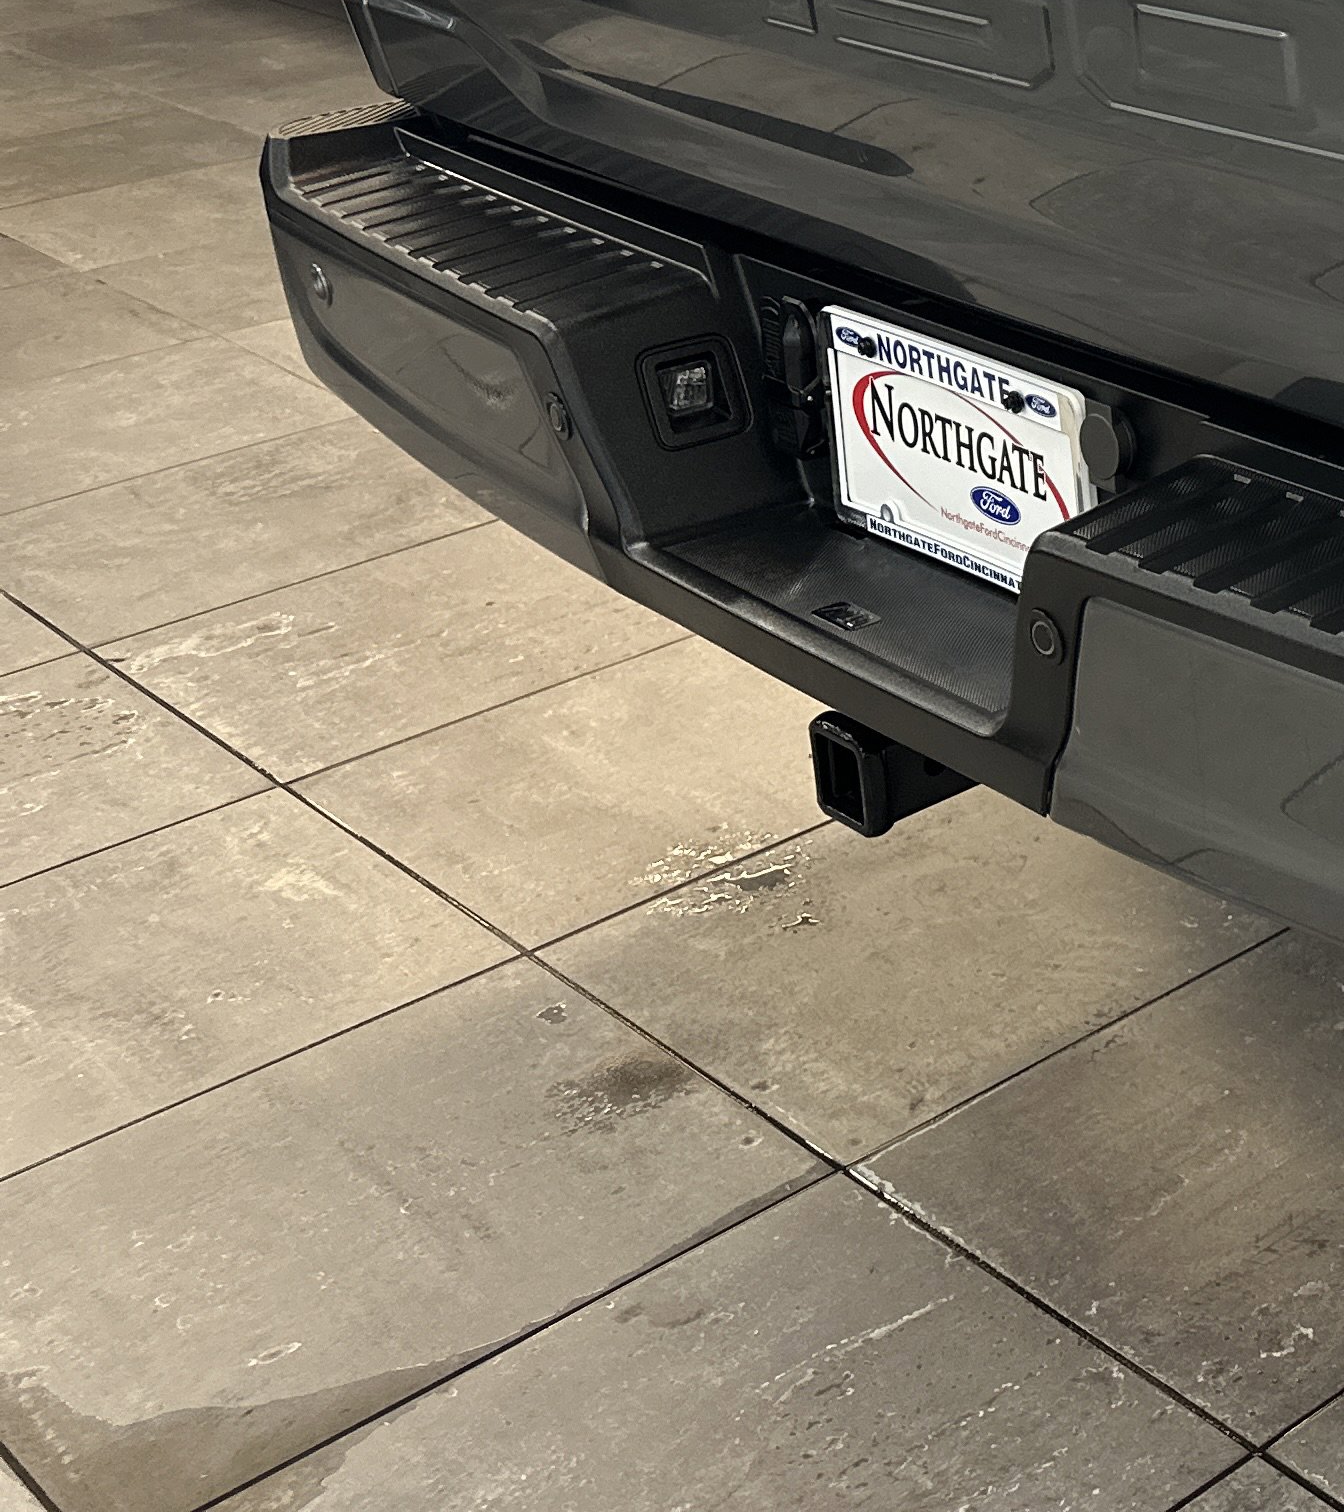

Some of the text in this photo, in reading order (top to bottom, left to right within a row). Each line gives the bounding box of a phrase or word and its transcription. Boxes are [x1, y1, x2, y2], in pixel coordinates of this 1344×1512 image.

[876, 333, 1011, 405] NORTHGATE
[870, 377, 1048, 501] NORTHGATE
[979, 490, 1012, 521] Ford
